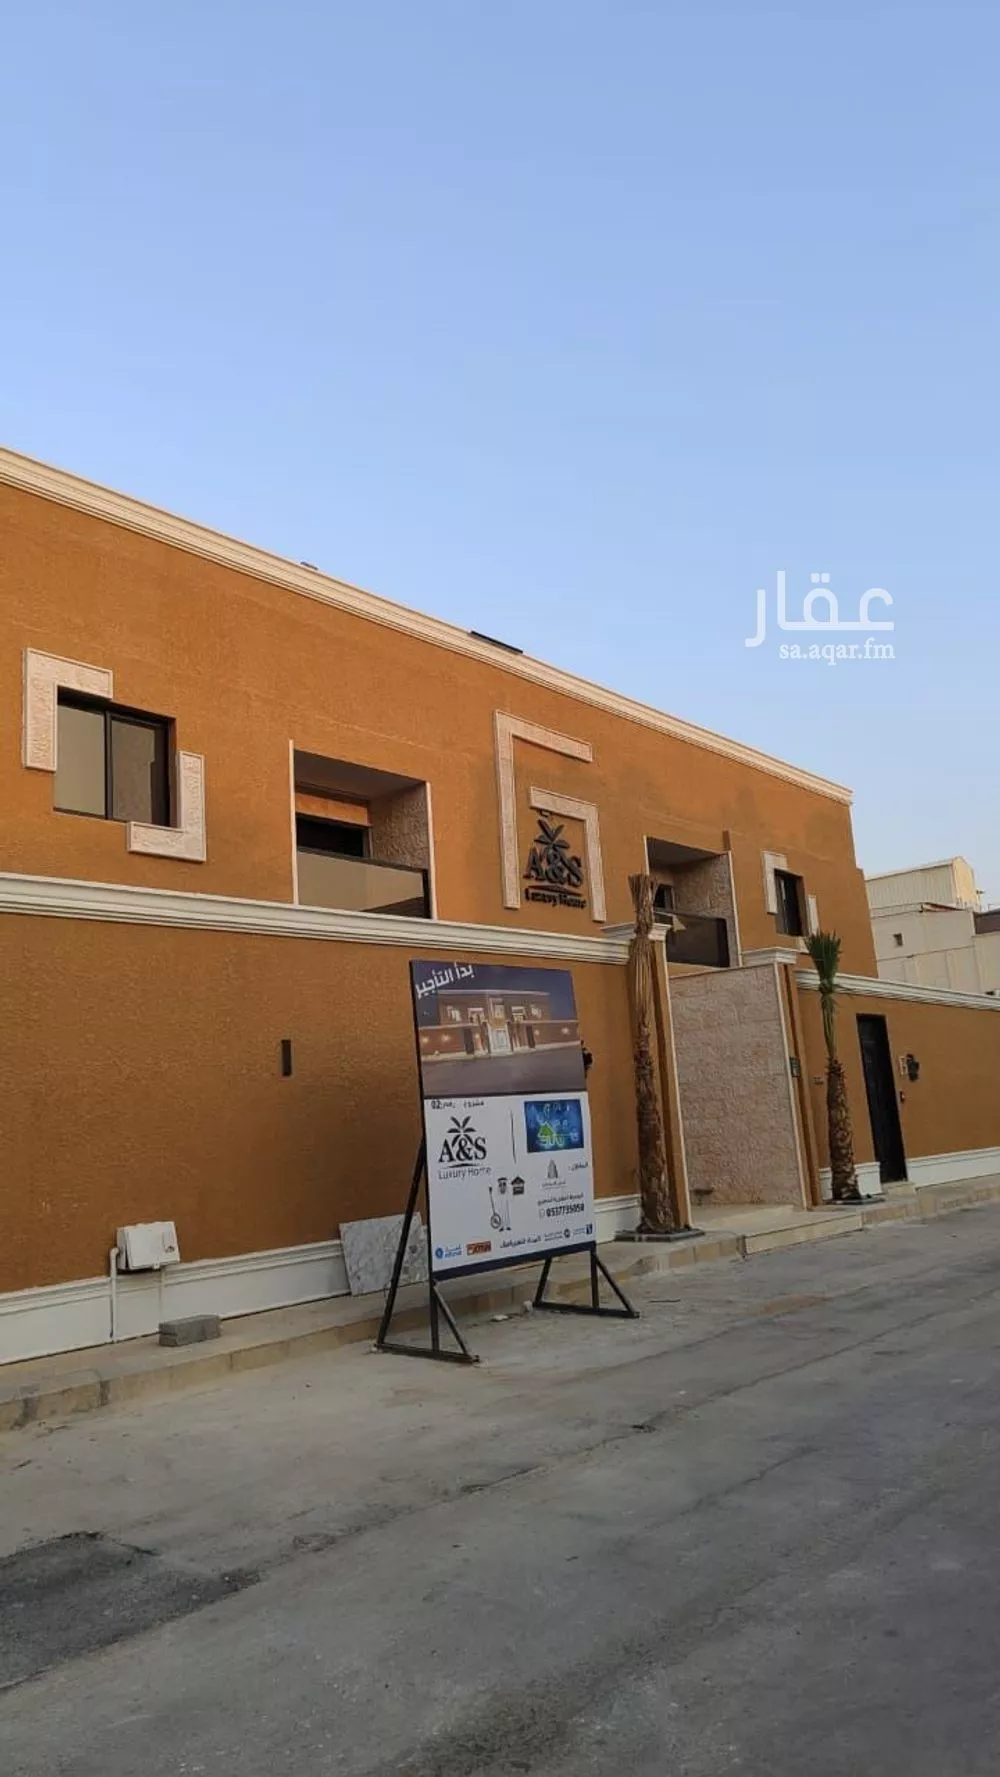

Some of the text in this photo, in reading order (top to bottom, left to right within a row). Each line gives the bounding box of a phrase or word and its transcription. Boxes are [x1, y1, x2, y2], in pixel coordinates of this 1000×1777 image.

[523, 846, 583, 888] A&S
[415, 968, 454, 1000] التأجير
[438, 1137, 488, 1163] A&S
[438, 1166, 492, 1180] Luxury Home
